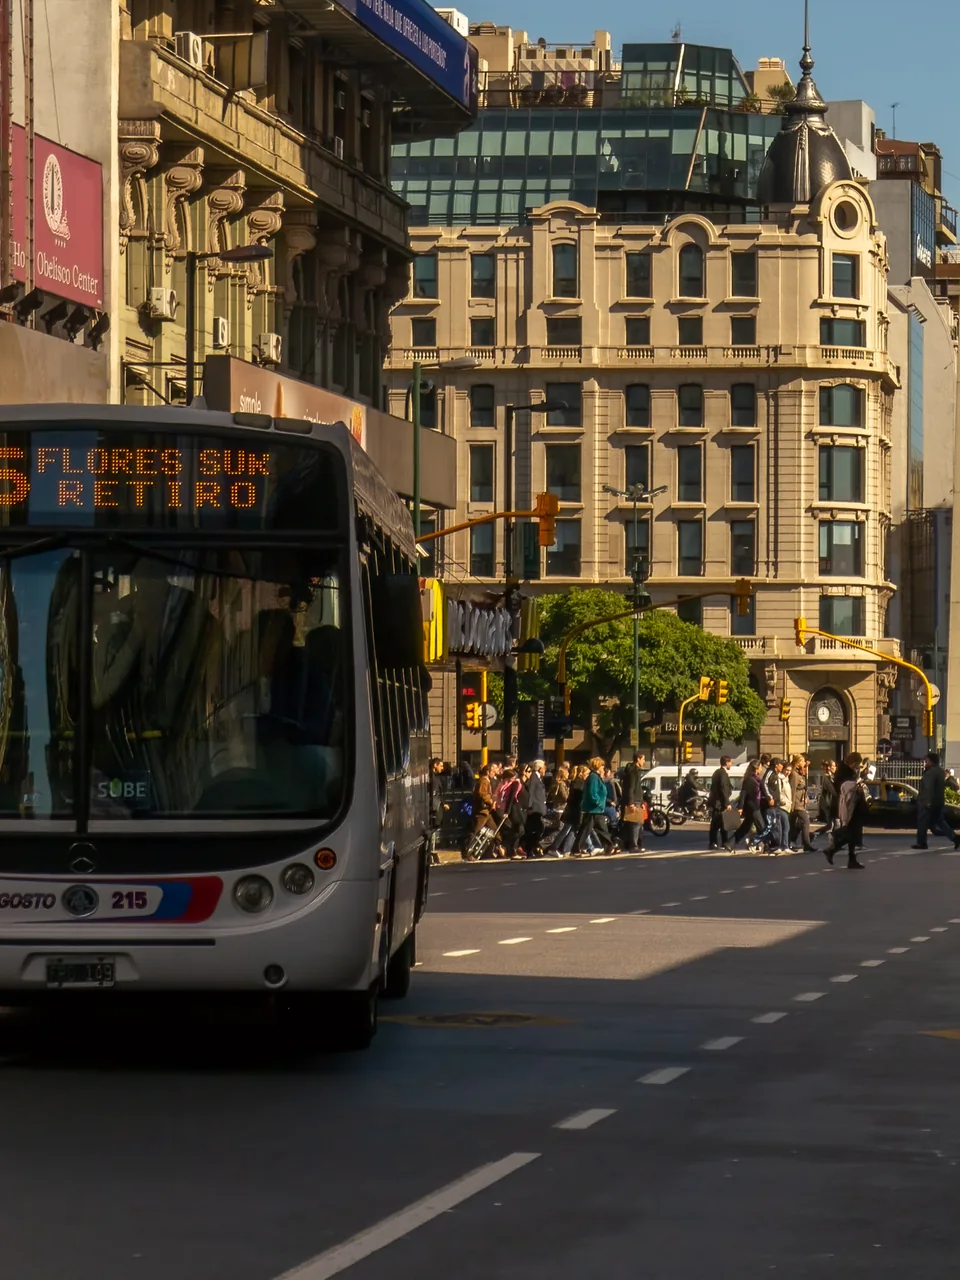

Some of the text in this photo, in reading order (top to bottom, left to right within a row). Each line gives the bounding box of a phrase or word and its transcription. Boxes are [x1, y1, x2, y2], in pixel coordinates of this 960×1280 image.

[37, 251, 98, 295] Obelisco Center
[38, 448, 183, 475] FLORES
[59, 480, 257, 507] RETIRO
[665, 722, 697, 731] Baco
[98, 781, 147, 798] SUBE
[112, 891, 148, 909] 215
